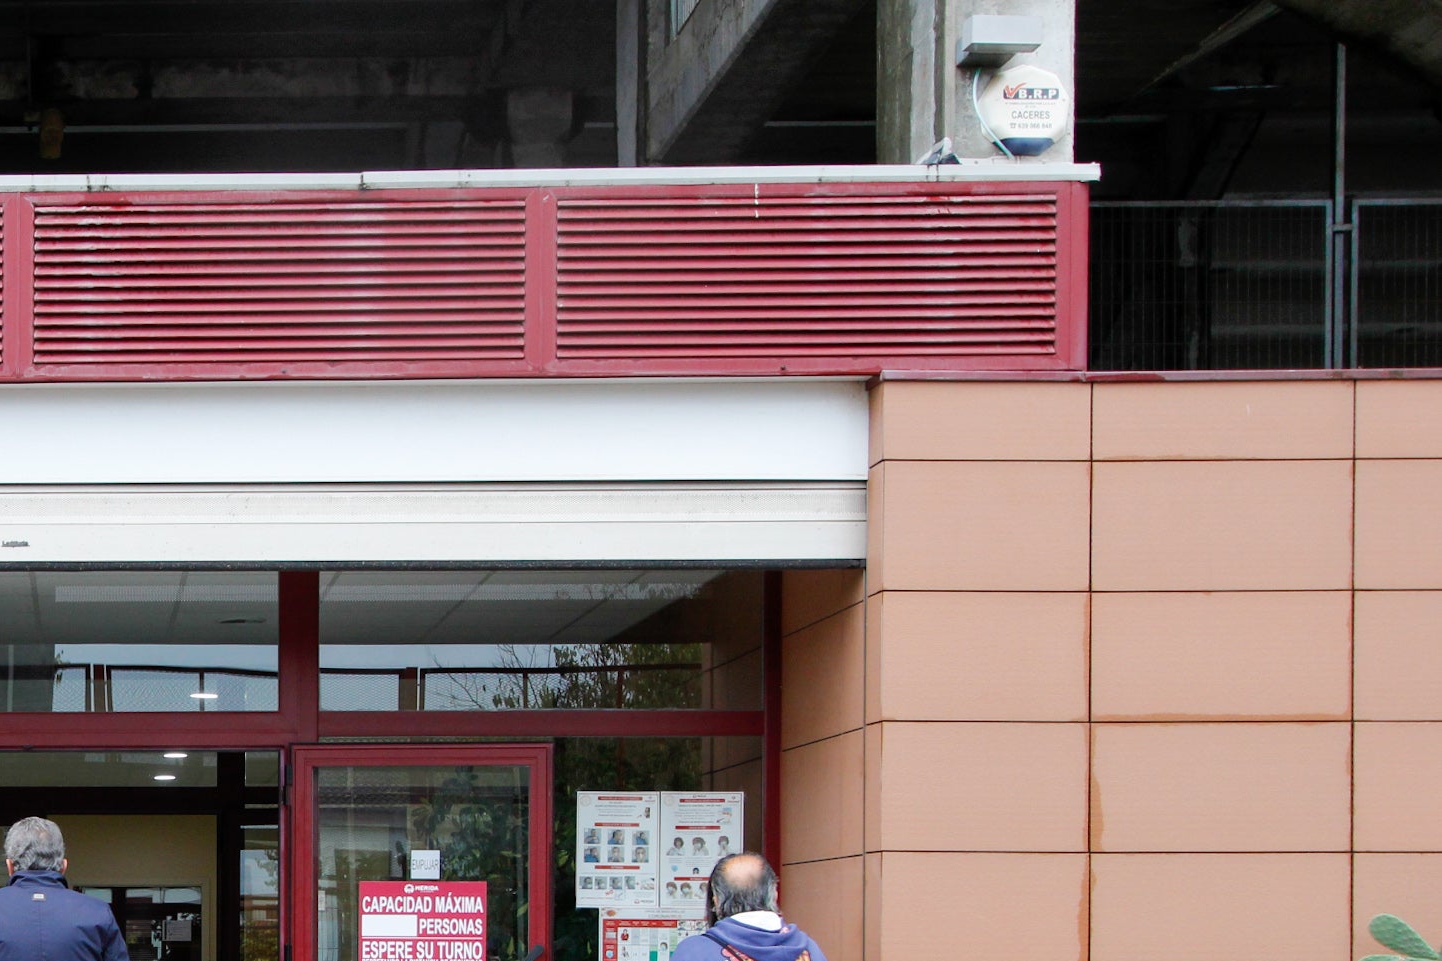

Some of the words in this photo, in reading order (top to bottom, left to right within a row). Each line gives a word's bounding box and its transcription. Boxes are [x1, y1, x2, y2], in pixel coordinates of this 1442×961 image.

[1019, 89, 1057, 99] B.R.P
[1011, 110, 1050, 119] CACERES
[411, 859, 439, 871] EMPUJAR
[362, 896, 432, 913] CAPACIDAD
[435, 892, 484, 913] MÁXIMA
[419, 918, 483, 935] PERSONAS
[362, 941, 413, 959] ESPERE
[416, 941, 434, 959] SU
[437, 942, 483, 959] TURNO
